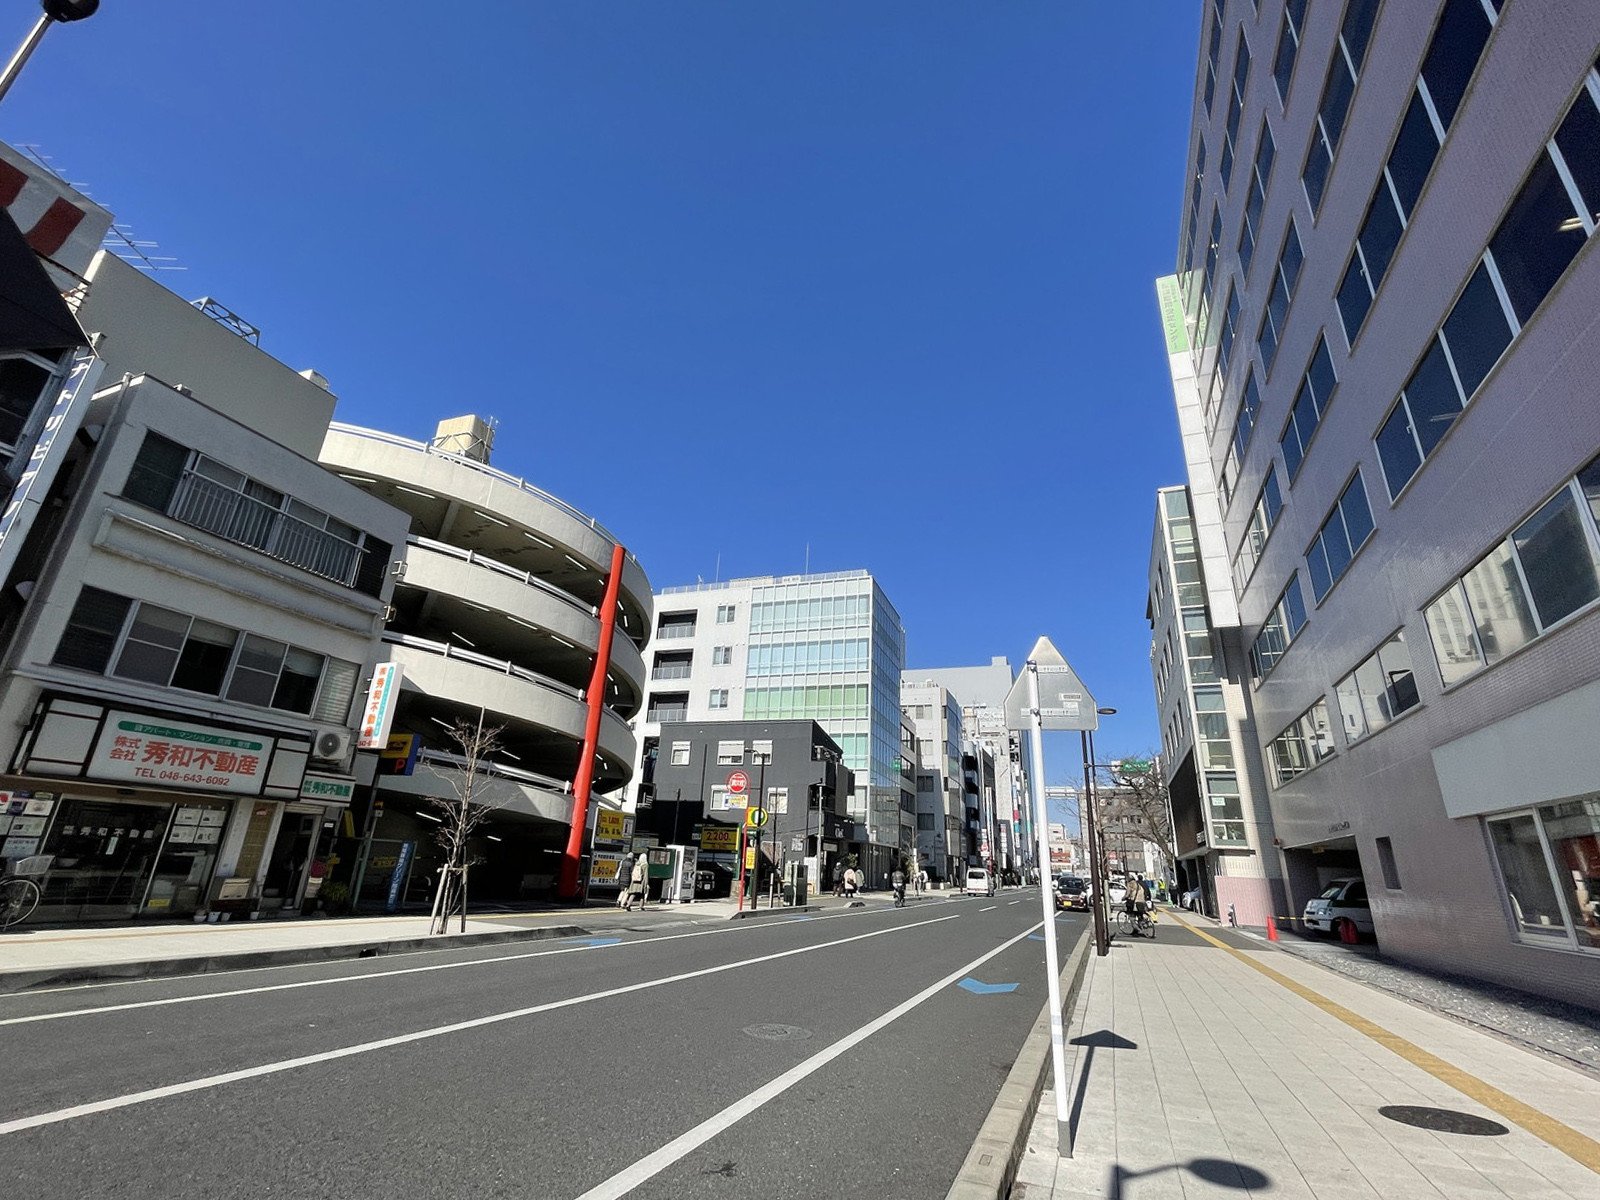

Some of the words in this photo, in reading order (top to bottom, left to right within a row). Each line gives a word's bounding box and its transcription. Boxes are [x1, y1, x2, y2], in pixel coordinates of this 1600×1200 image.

[114, 735, 141, 749] 株式
[109, 748, 137, 761] 会社
[141, 740, 259, 776] 秀和不動産
[134, 767, 156, 778] TEL
[159, 771, 230, 786] 048-643-6092
